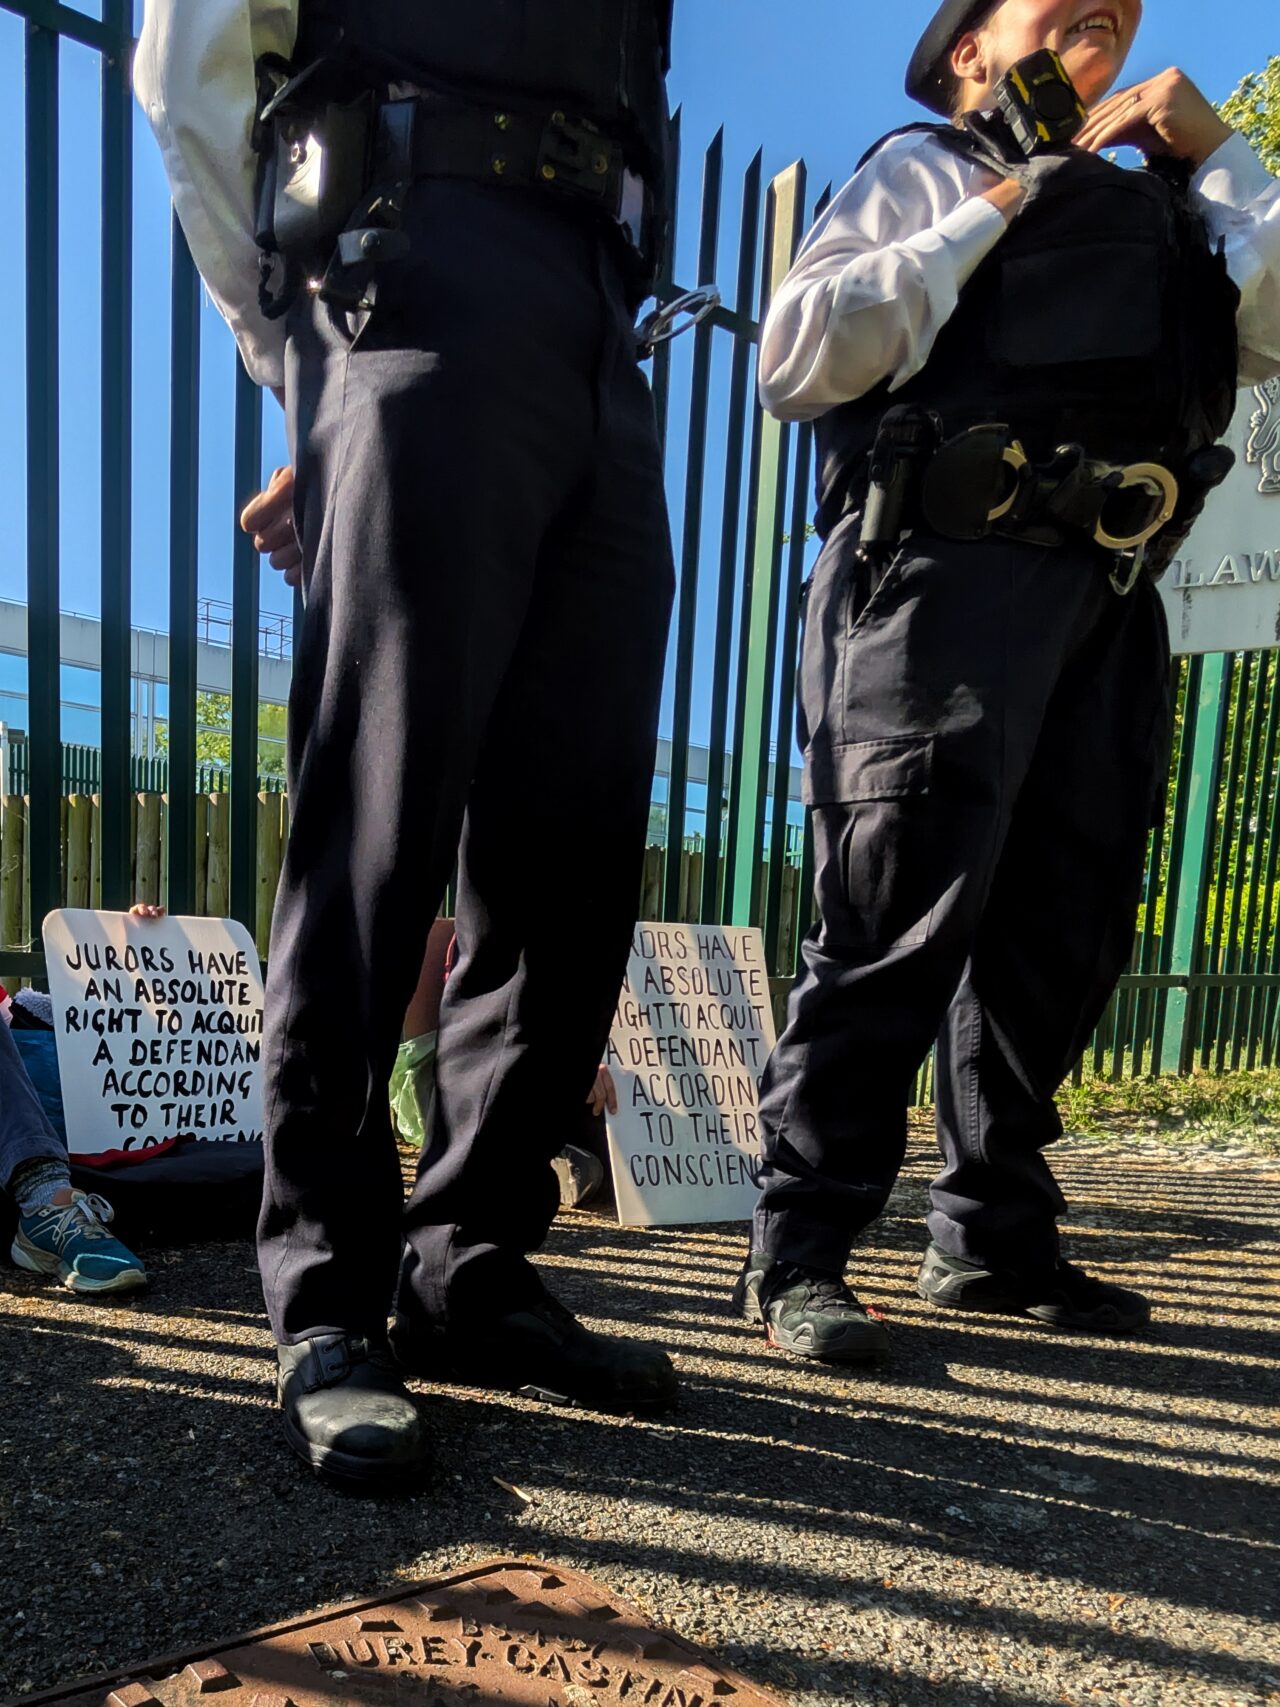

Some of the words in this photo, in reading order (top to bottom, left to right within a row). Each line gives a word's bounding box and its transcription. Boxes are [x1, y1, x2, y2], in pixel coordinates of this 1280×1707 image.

[66, 943, 174, 972] JURORS
[188, 951, 249, 975] HAVE
[699, 936, 756, 962] HAVE
[85, 978, 123, 1003] AN
[135, 978, 251, 1005] ABSOLUTE
[644, 966, 763, 996] ABSOLUTE
[65, 1008, 142, 1037] RIGHT
[155, 1010, 182, 1035] TO
[191, 1009, 263, 1035] ACQUIT
[614, 1001, 666, 1031] IGHT
[670, 1002, 691, 1030] TO
[697, 1000, 764, 1031] ACQUIT
[92, 1039, 113, 1066] A
[129, 1039, 260, 1066] DEFENDAN
[607, 1041, 624, 1066] A
[629, 1035, 759, 1069] DEFENDANT
[102, 1069, 253, 1099] ACCORDING
[111, 1103, 148, 1128] TO
[160, 1099, 237, 1129] THEIR
[640, 1111, 673, 1146] TO
[689, 1108, 757, 1144] THEIR
[305, 1634, 484, 1670] DUREY
